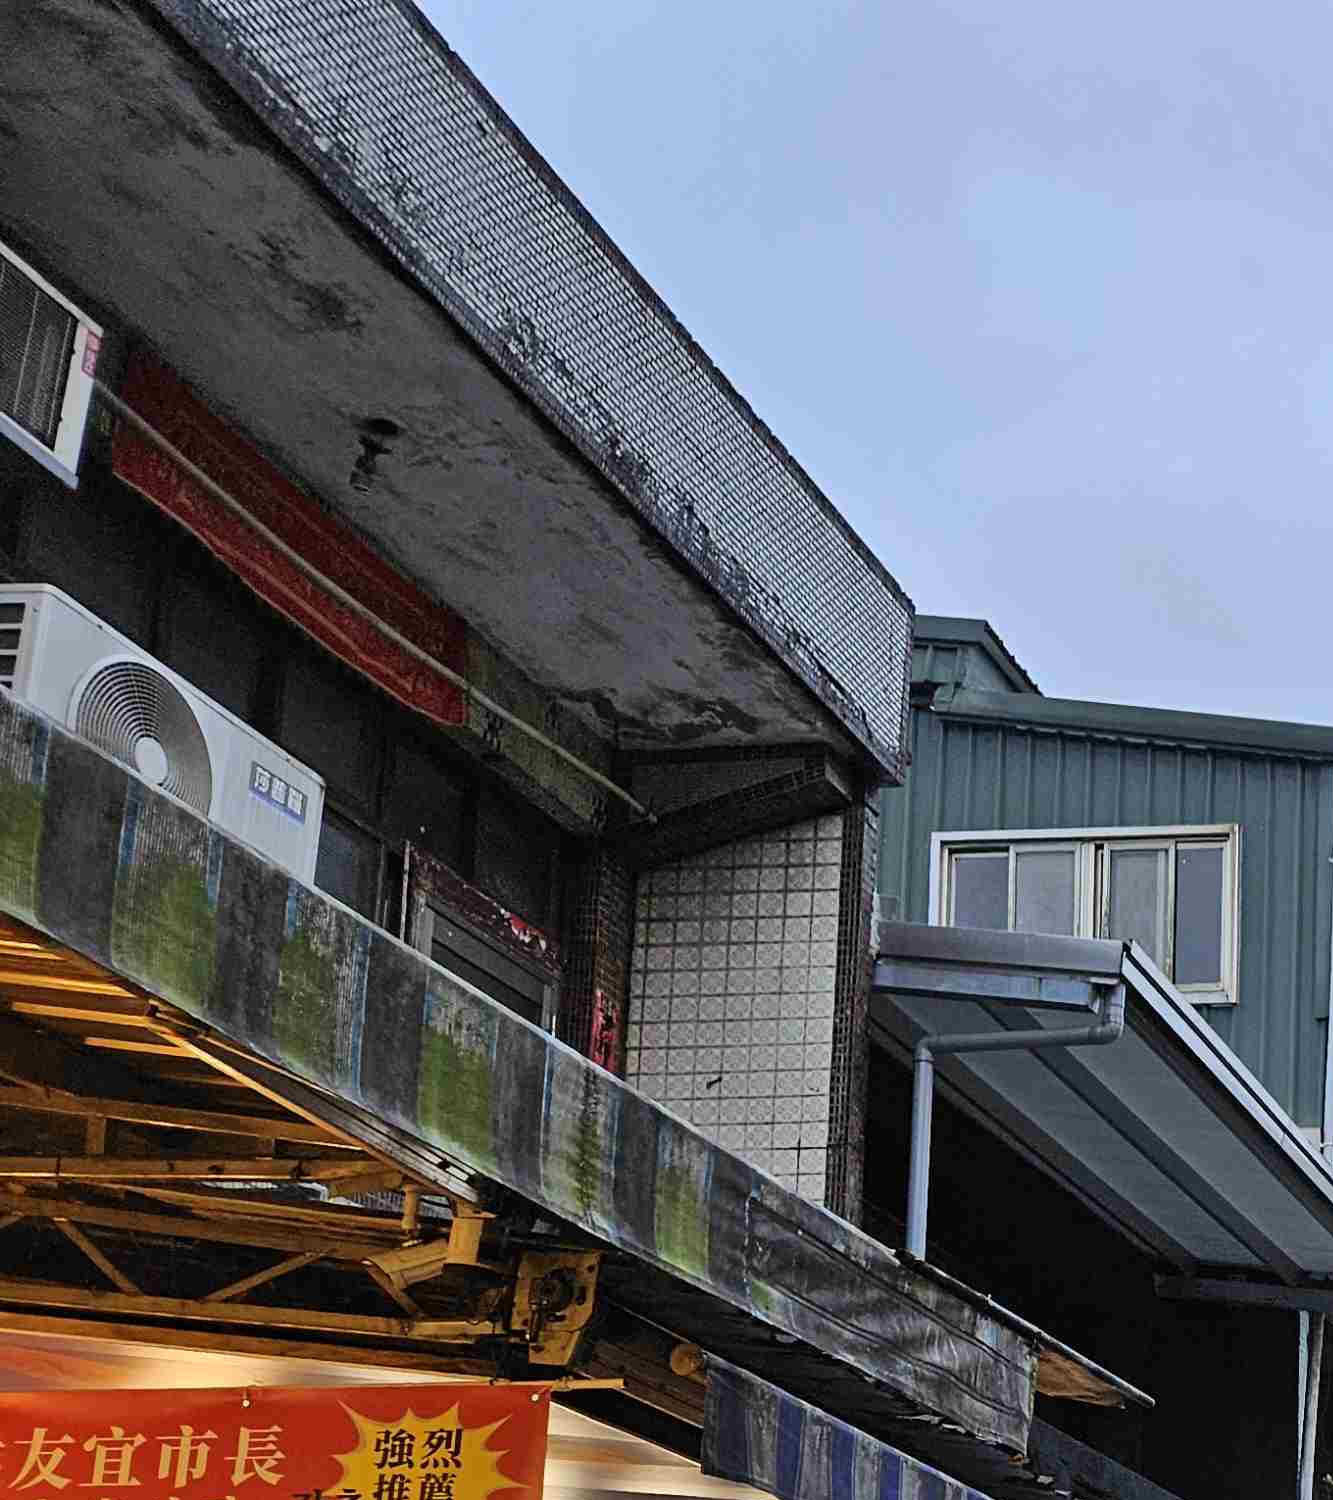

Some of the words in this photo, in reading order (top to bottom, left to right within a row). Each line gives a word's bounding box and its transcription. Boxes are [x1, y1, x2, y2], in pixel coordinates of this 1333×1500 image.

[0, 1425, 287, 1489] 友宜市長
[374, 1428, 463, 1469] 強烈
